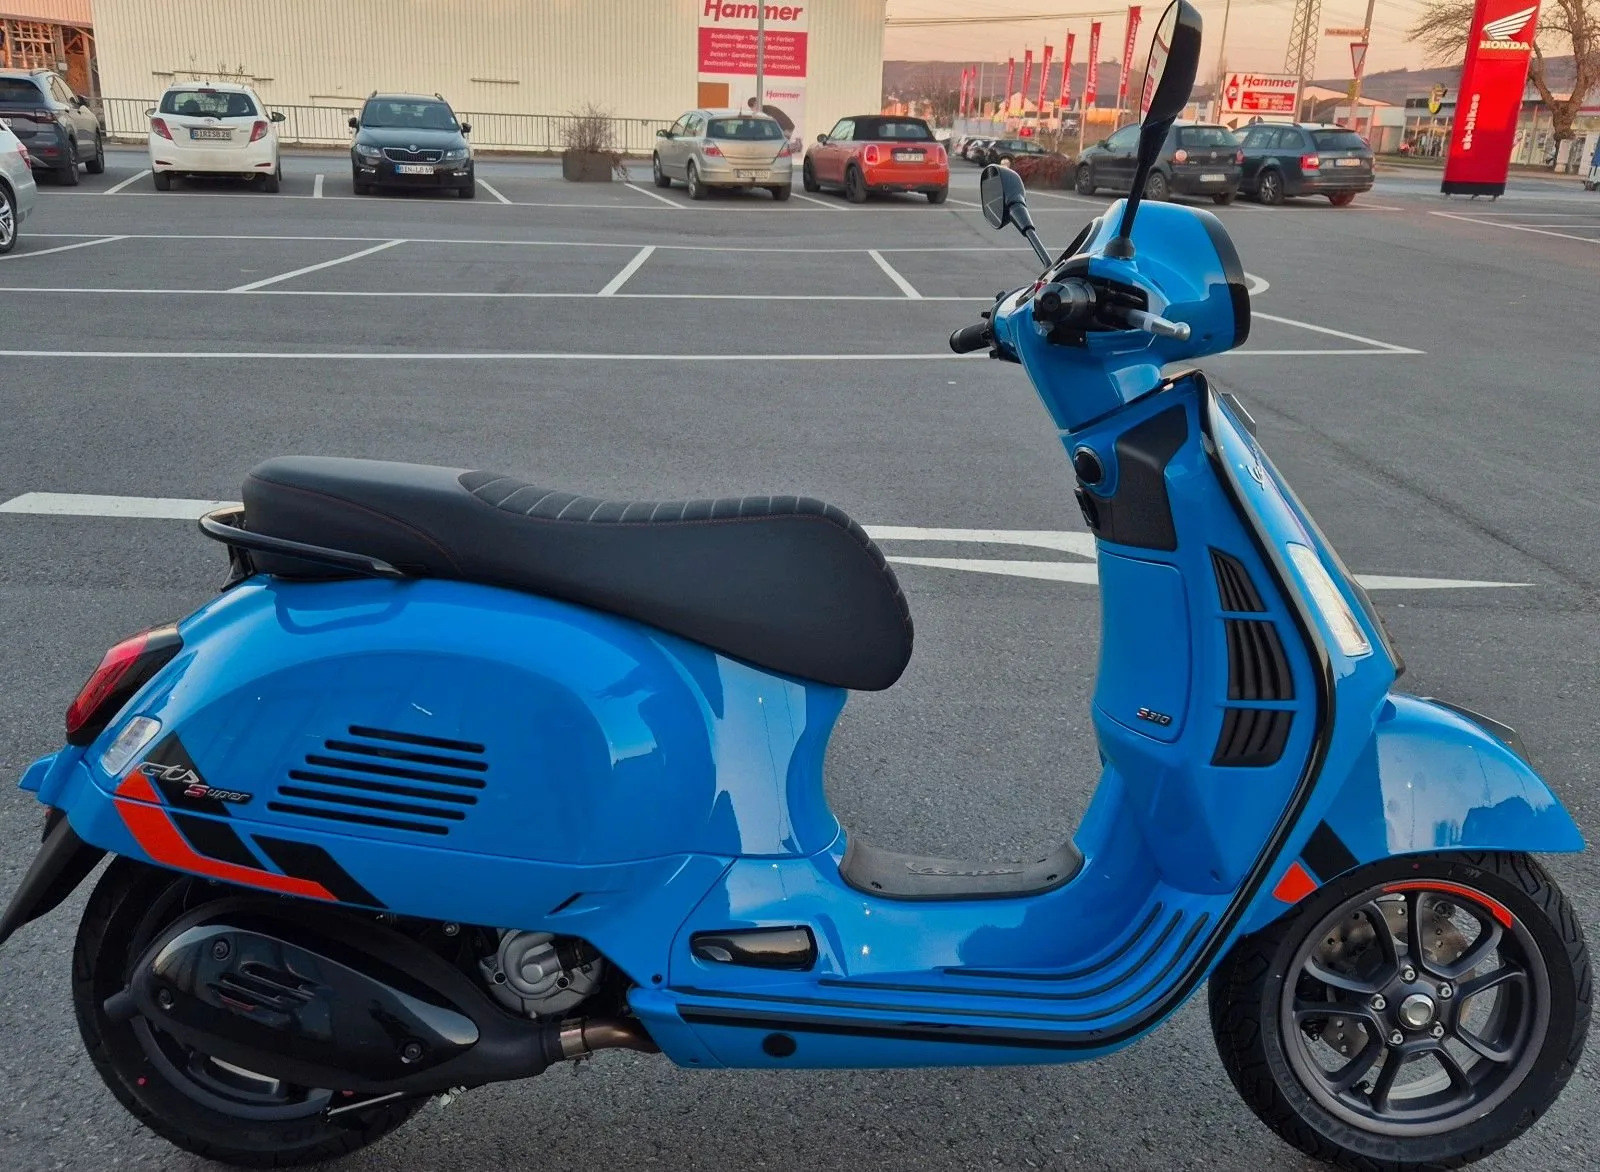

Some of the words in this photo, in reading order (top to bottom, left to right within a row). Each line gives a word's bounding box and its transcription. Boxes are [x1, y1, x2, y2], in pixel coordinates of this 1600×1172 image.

[704, 0, 803, 21] Hammer
[1480, 40, 1531, 50] HONDA
[1243, 75, 1298, 88] Hammer
[766, 90, 800, 99] Hammer
[1462, 94, 1480, 150] sk-bikes
